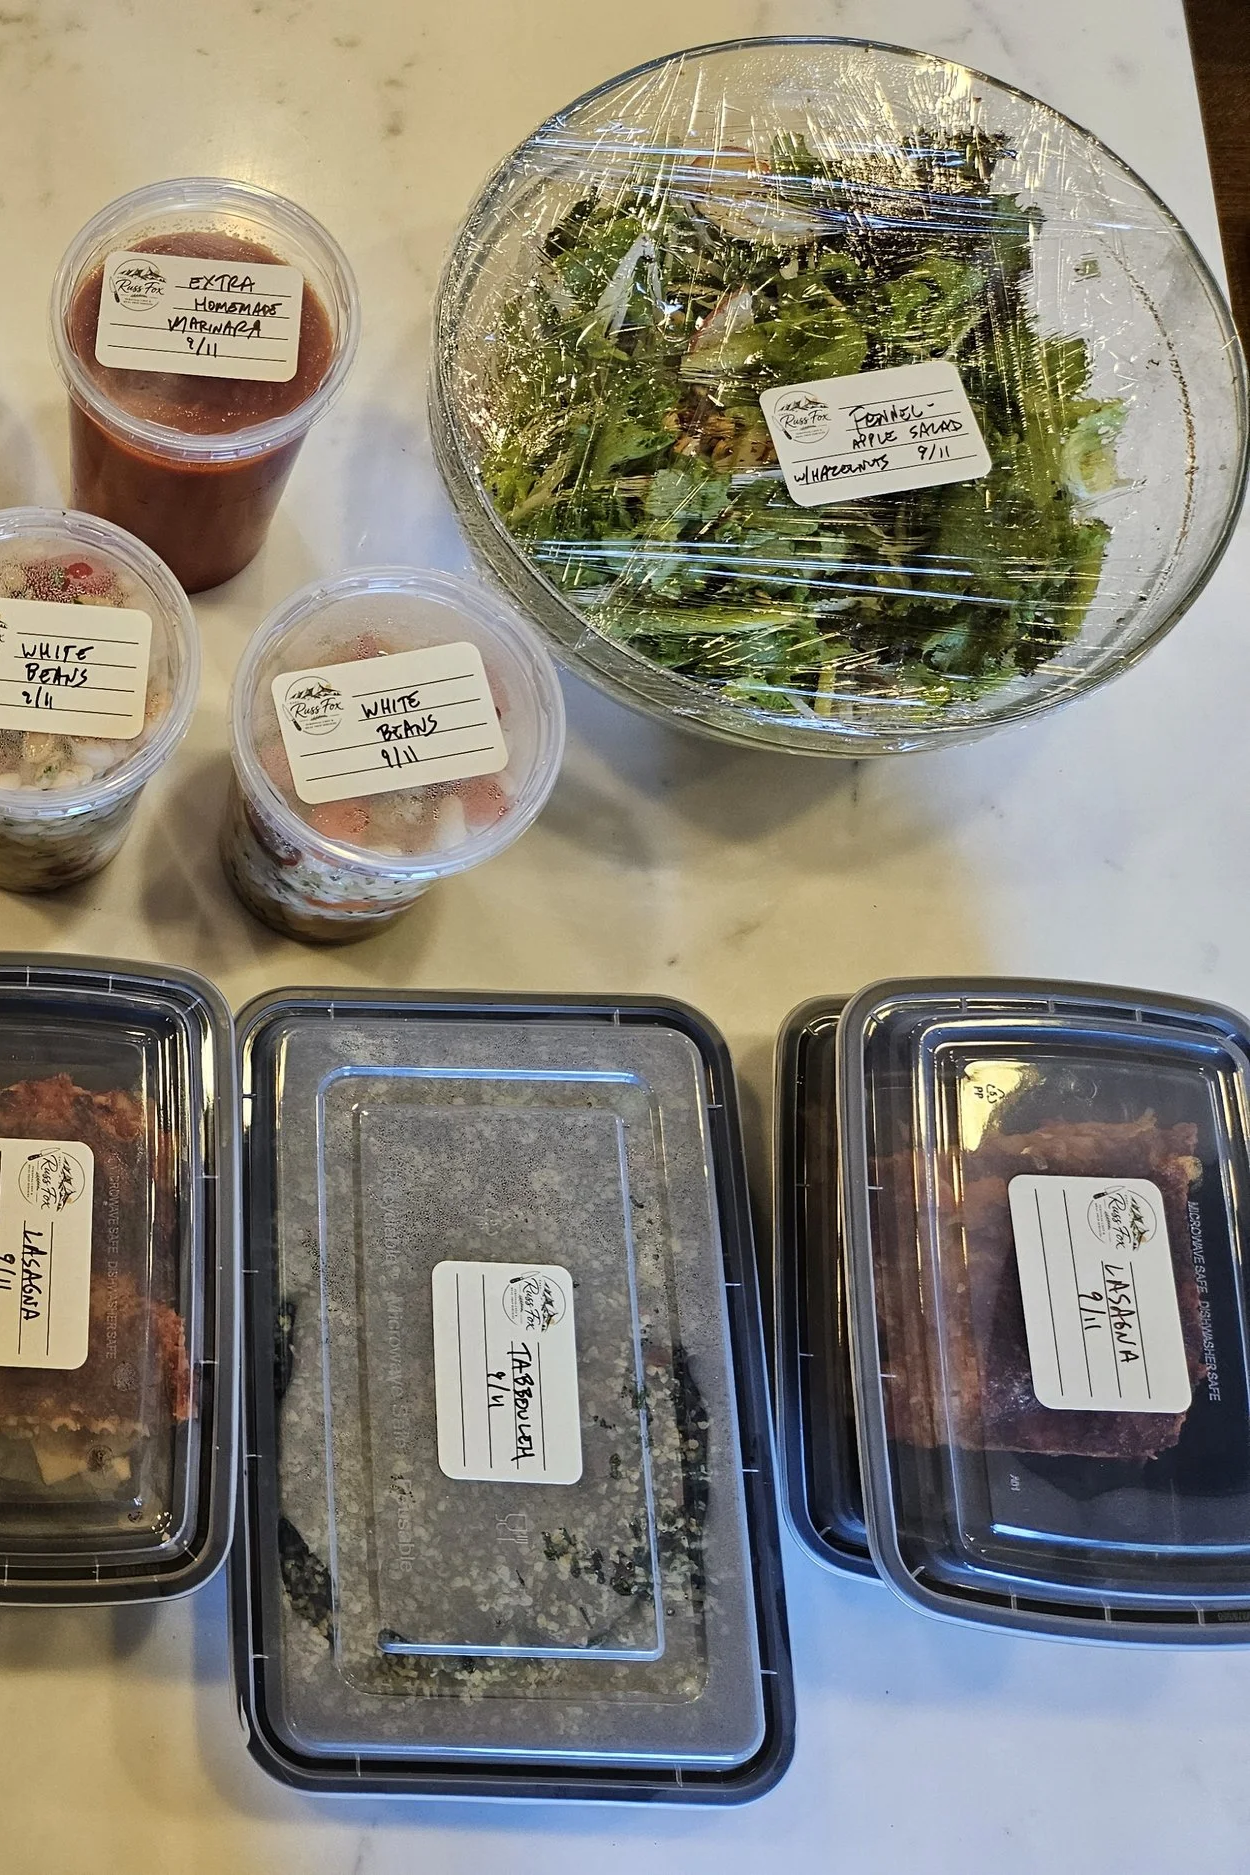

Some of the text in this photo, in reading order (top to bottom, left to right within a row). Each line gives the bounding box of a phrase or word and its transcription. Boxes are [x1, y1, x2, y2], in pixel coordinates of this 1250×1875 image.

[115, 278, 166, 297] Russ Fox
[188, 273, 256, 294] EXTRA
[194, 296, 283, 317] HOMEMADE
[167, 316, 262, 340] MARINARA
[779, 409, 832, 430] Russ Fox
[852, 418, 963, 450] APPLE SALAD
[917, 443, 950, 460] 9/11
[20, 642, 95, 663] WHITE
[24, 662, 89, 688] BEANS
[289, 697, 345, 719] Russ Fox
[360, 690, 422, 720] WHITE
[375, 713, 439, 742] BEANS
[380, 745, 421, 769] 9/11
[39, 1154, 60, 1211] Russ Fox
[1107, 1192, 1132, 1250] Russ Fox
[20, 1230, 48, 1321] LASAGNA
[523, 1277, 541, 1331] Russ Fox
[1077, 1291, 1107, 1331] 9/11
[1103, 1263, 1141, 1364] LASAGNA
[1187, 1200, 1222, 1402] MICROWAVE SAFE DISHWASHER SAFE
[486, 1371, 512, 1409] 9/11
[506, 1341, 536, 1462] TABBOULEH
